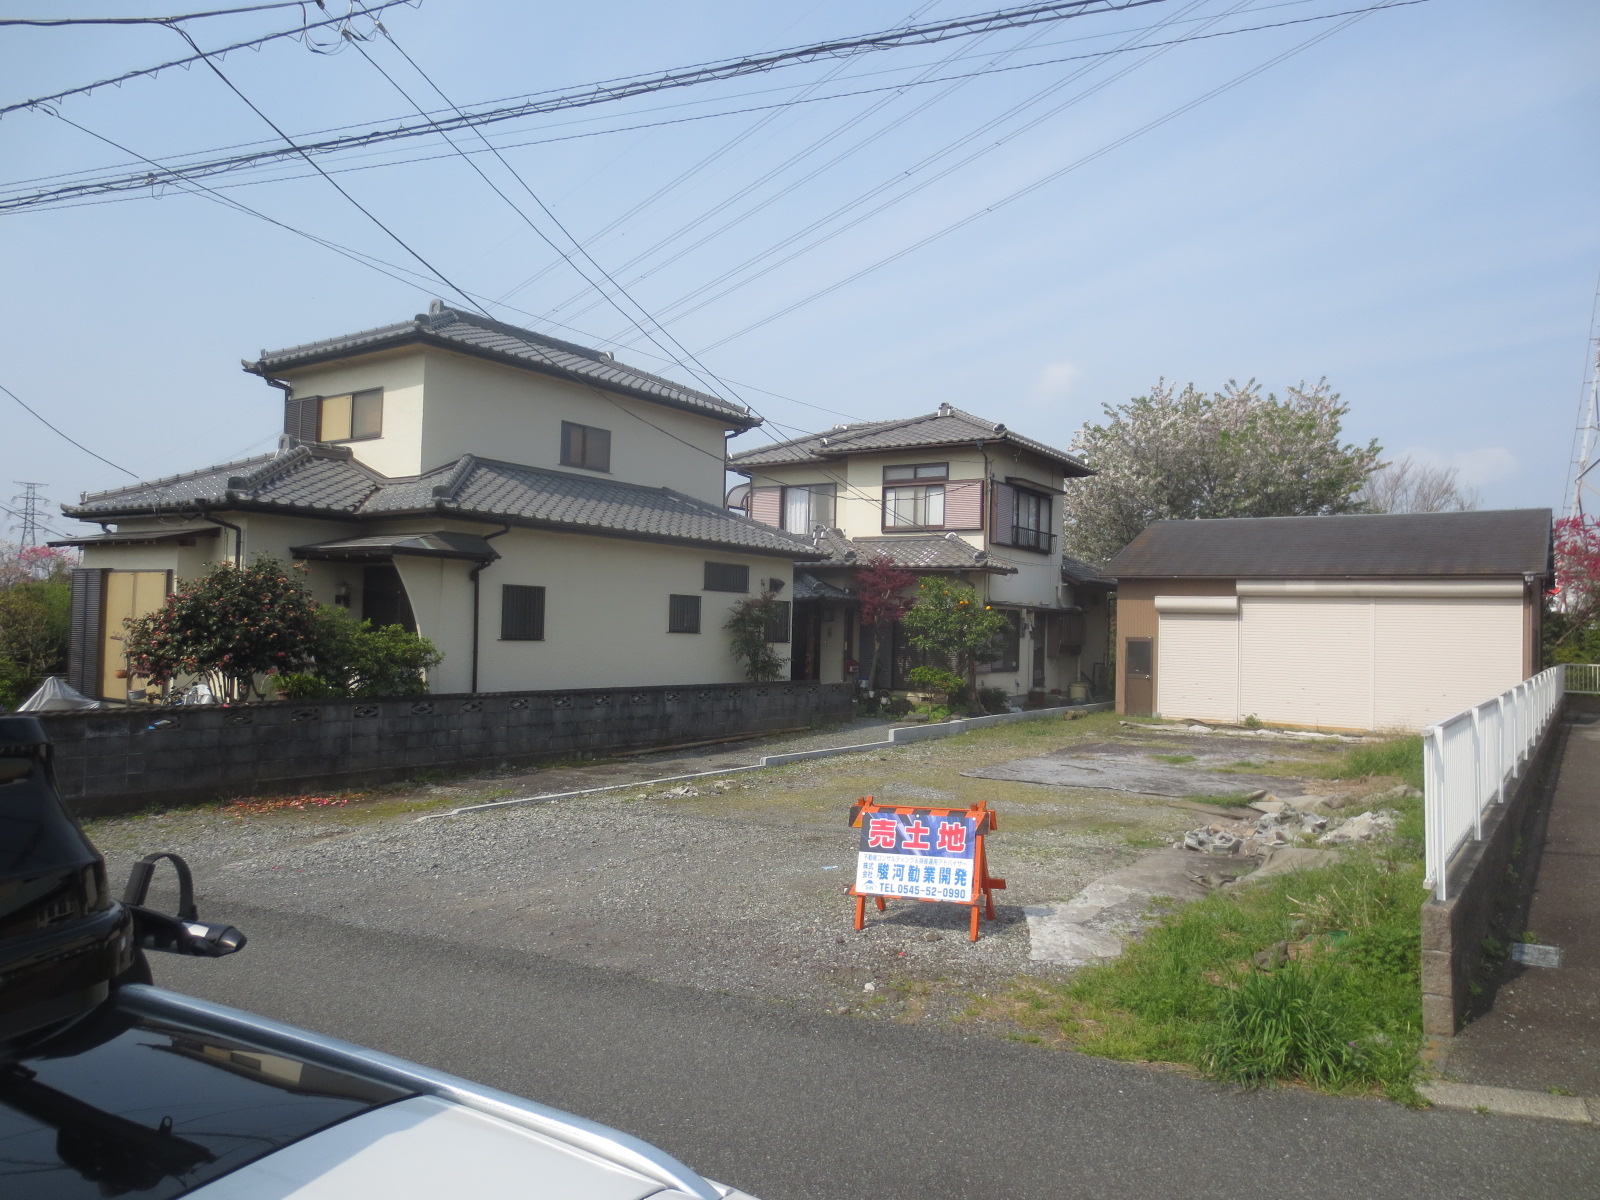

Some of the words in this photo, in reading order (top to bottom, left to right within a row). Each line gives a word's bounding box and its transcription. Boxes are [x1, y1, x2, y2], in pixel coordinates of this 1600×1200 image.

[868, 818, 966, 852] 売土地
[877, 862, 968, 886] 駿河勧業開発
[879, 883, 895, 893] TEL
[897, 884, 966, 899] 0545-52-0990
